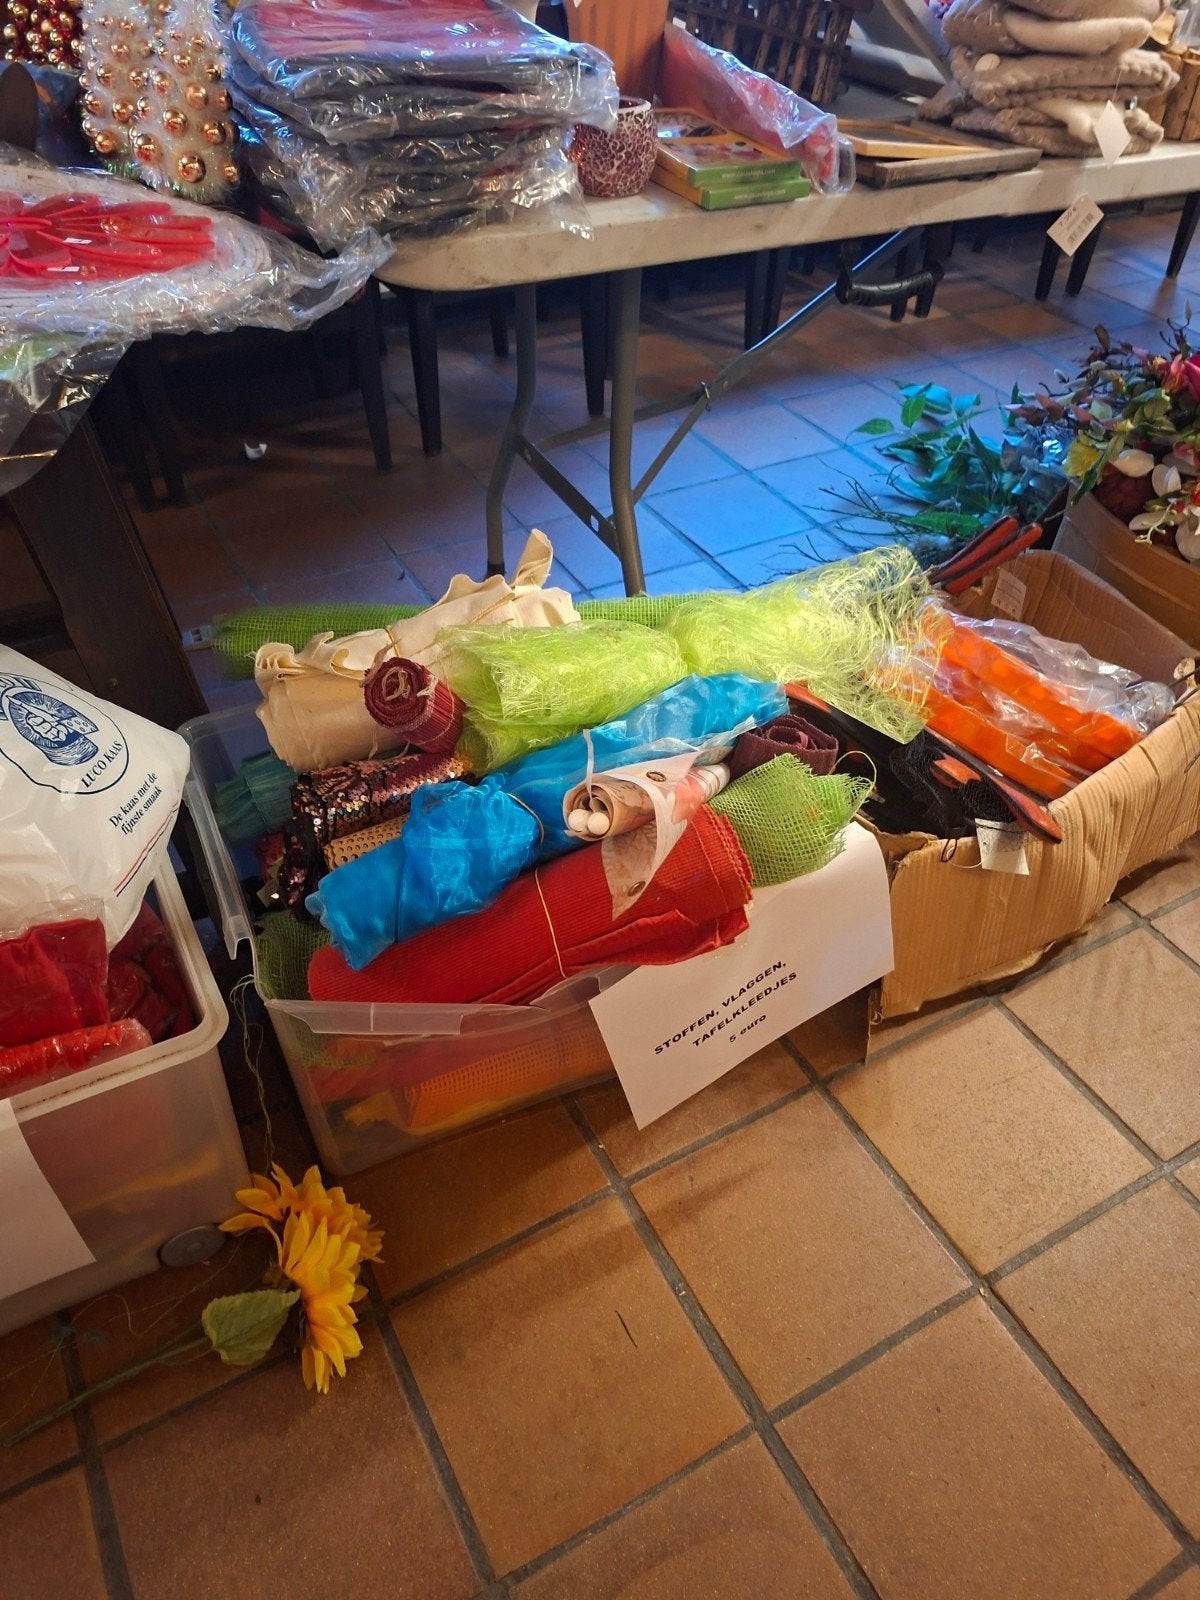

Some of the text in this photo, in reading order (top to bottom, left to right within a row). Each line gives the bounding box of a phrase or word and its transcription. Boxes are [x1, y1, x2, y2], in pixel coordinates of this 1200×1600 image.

[81, 740, 123, 788] LUCO KAAS
[109, 771, 158, 828] De kaas met de
[121, 786, 163, 836] fijnste smaak
[654, 960, 787, 1055] STOFFEN, VLAGGEN,
[692, 971, 797, 1047] TAFELKLEEDJES
[729, 1013, 767, 1043] 5 euro
